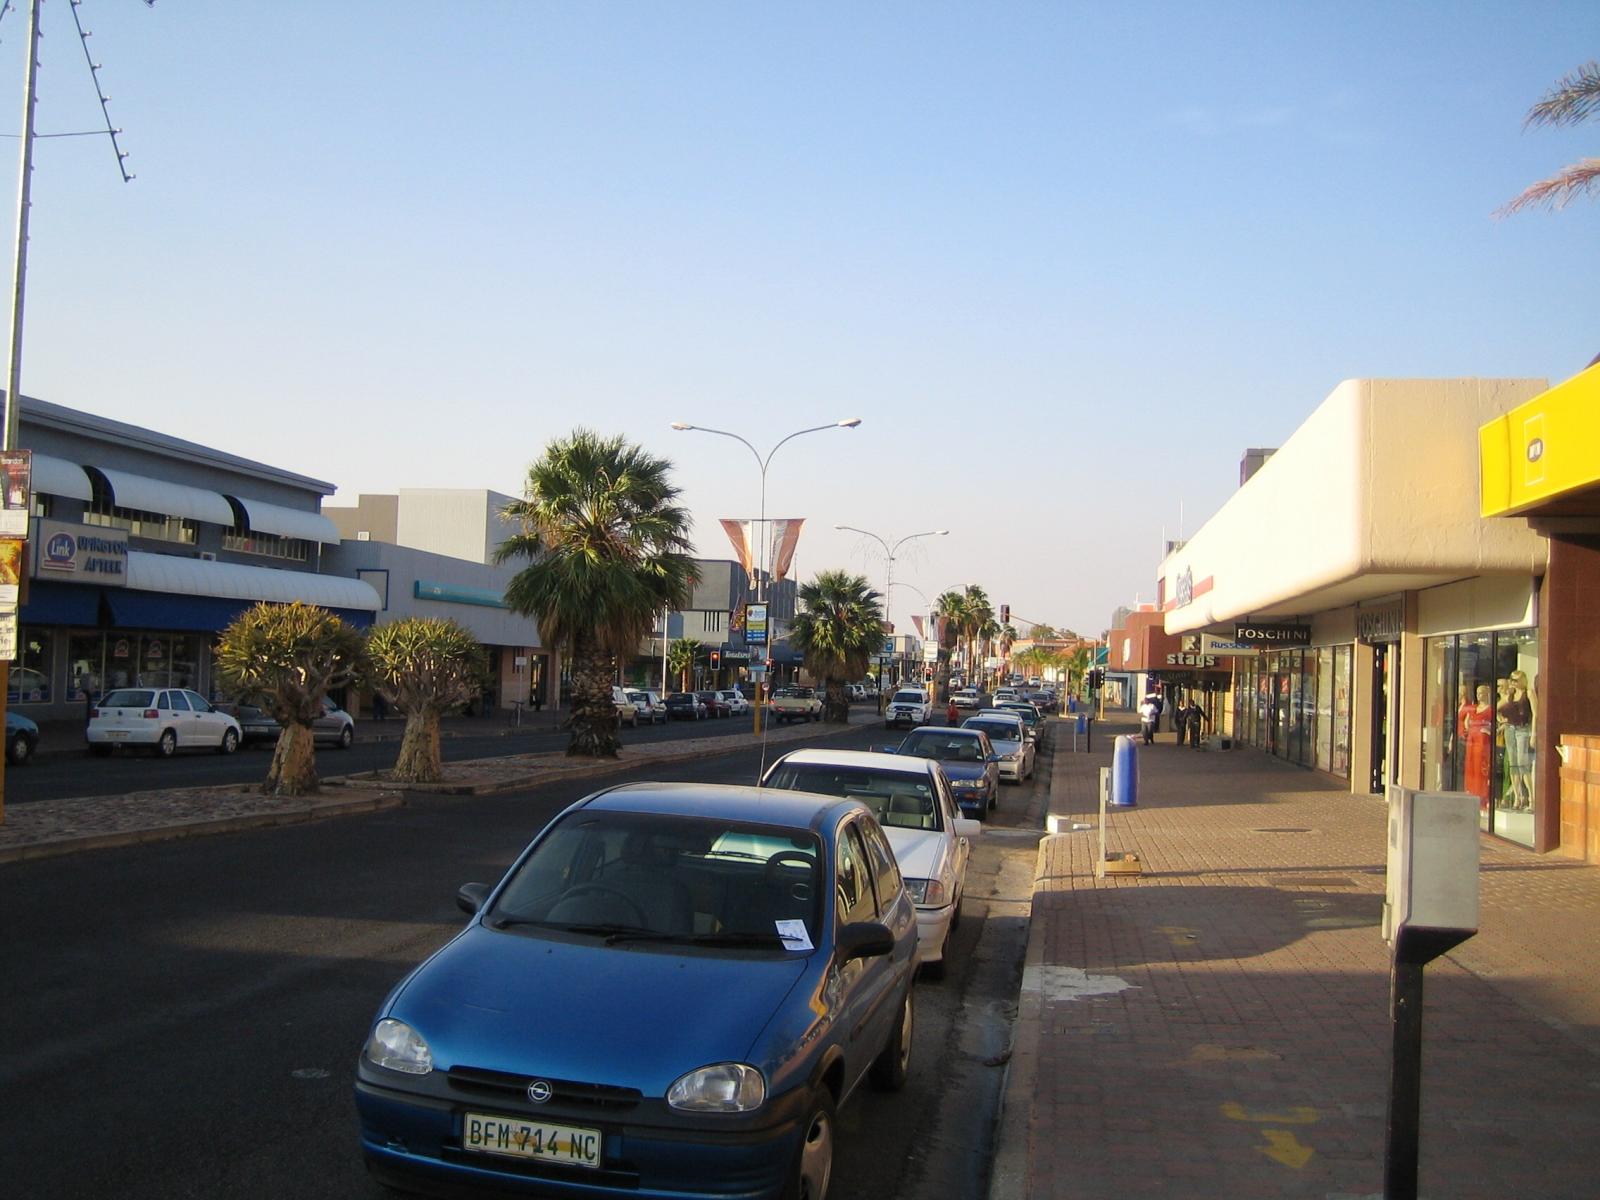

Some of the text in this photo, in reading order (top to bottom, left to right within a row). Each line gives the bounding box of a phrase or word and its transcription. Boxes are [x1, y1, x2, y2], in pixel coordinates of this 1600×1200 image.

[51, 540, 70, 557] Link
[1237, 628, 1307, 640] FOSCHINI
[1167, 653, 1216, 668] stags
[470, 1119, 596, 1161] BFM 714 NC
